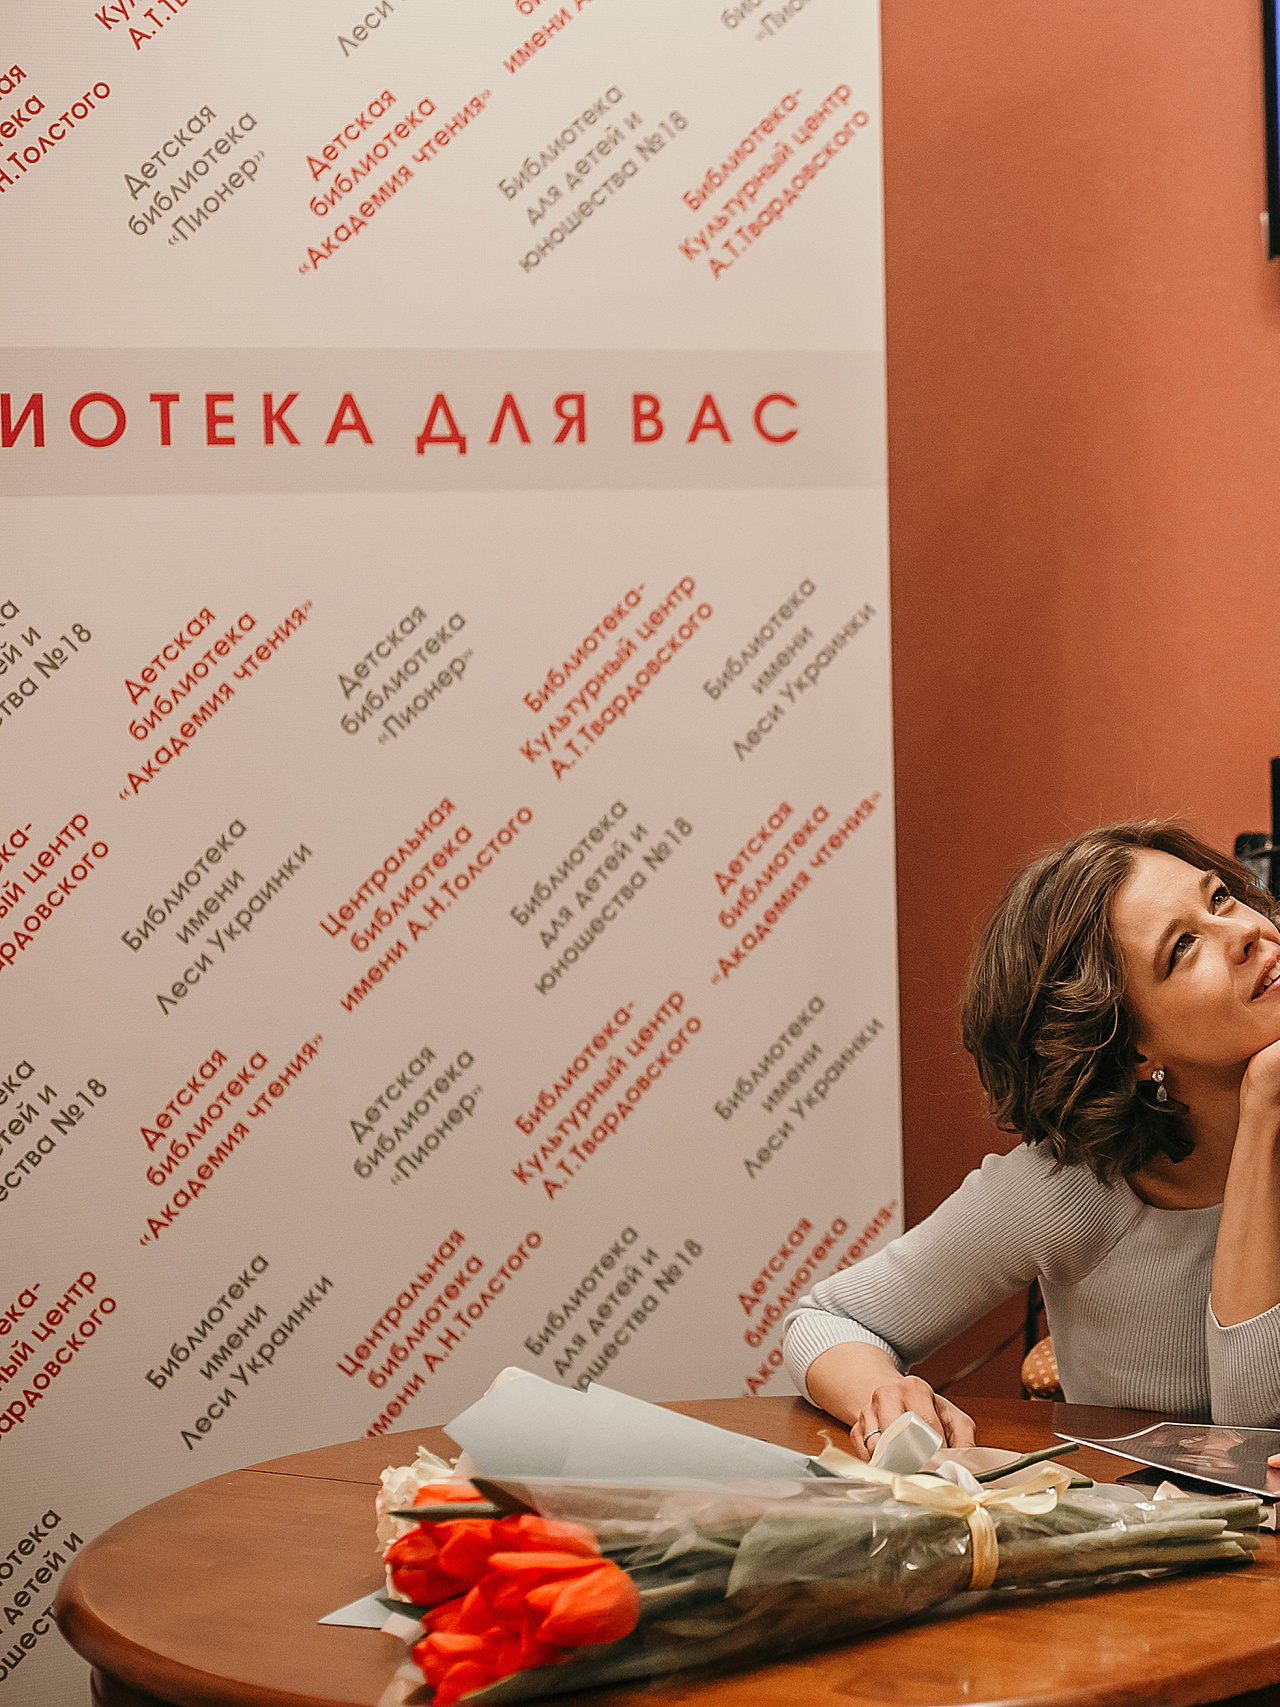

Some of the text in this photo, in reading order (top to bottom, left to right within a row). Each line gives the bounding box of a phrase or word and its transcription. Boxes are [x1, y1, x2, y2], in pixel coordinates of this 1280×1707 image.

[338, 0, 394, 56] Леси
[504, 8, 572, 74] имени
[124, 105, 216, 200] Детская
[128, 113, 257, 235] библиотека
[168, 151, 264, 245] «Пионер»
[299, 90, 490, 274] «Академия чтения»
[306, 90, 397, 182] Детская
[309, 98, 436, 217] библиотека
[498, 85, 622, 199] Библиотека
[520, 112, 687, 272] юношества №18
[527, 111, 642, 225] для детей и
[679, 84, 851, 260] Культурный центр
[682, 91, 800, 211] Библиотека-
[709, 111, 868, 279] А.Т.Твардовского
[415, 392, 587, 456] ДЛЯ
[632, 392, 798, 445] ВАС
[21, 626, 41, 647] и
[33, 623, 91, 679] №18
[124, 607, 216, 706] Детская
[129, 612, 256, 741] библиотека
[338, 606, 427, 700] Детская
[341, 613, 466, 734] библиотека
[379, 650, 472, 743] «Пионер»
[520, 577, 695, 763] Культурный центр
[523, 584, 644, 713] Библиотека-
[551, 603, 712, 780] А.Т.Твардовского
[703, 580, 815, 700] Библиотека
[734, 605, 874, 761] Леси Украинки
[752, 627, 812, 694] имени
[119, 601, 312, 800] «Академия чтения»
[22, 814, 89, 884] центр
[121, 819, 247, 952] Библиотека
[176, 870, 245, 944] имени
[319, 798, 456, 938] Центральная
[340, 807, 533, 1012] имени А.Н.Толстого
[350, 825, 473, 952] библиотека
[510, 801, 627, 926] Библиотека
[535, 818, 692, 995] юношества №18
[540, 824, 647, 949] для детей и
[711, 792, 881, 984] «Академия чтения»
[714, 802, 793, 896] Детская
[718, 805, 829, 929] библиотека
[156, 844, 312, 1015] Леси Украинки
[50, 1078, 107, 1135] №18
[140, 1049, 228, 1152] Детская
[146, 1051, 268, 1186] библиотека
[350, 1047, 436, 1144] Детская
[354, 1050, 474, 1178] библиотека
[512, 992, 684, 1185] Культурный центр
[514, 1002, 633, 1136] Библиотека-
[543, 1017, 702, 1200] А.Т.Твардовского
[714, 996, 824, 1120] Библиотека
[744, 1019, 882, 1178] Леси Украинки
[762, 1044, 822, 1112] имени
[0, 1101, 40, 1156] тей
[37, 1085, 57, 1105] и
[139, 1034, 323, 1246] «Академия чтения»
[391, 1086, 482, 1185] «Пионер»
[524, 1227, 638, 1356] Библиотека
[830, 1200, 897, 1275] тения»
[31, 1271, 97, 1342] центр
[145, 1255, 269, 1390] Библиотека
[180, 1275, 333, 1451] Леси Украинки
[199, 1305, 268, 1381] имени
[336, 1230, 466, 1378] Центральная
[367, 1255, 484, 1389] библиотека
[423, 1231, 542, 1374] А.Н.Толстого
[552, 1248, 659, 1377] для детей и
[573, 1239, 702, 1392] ошества №18
[0, 1297, 117, 1441] ардовского
[0, 1509, 62, 1587] отека
[3, 1532, 84, 1626] детей и
